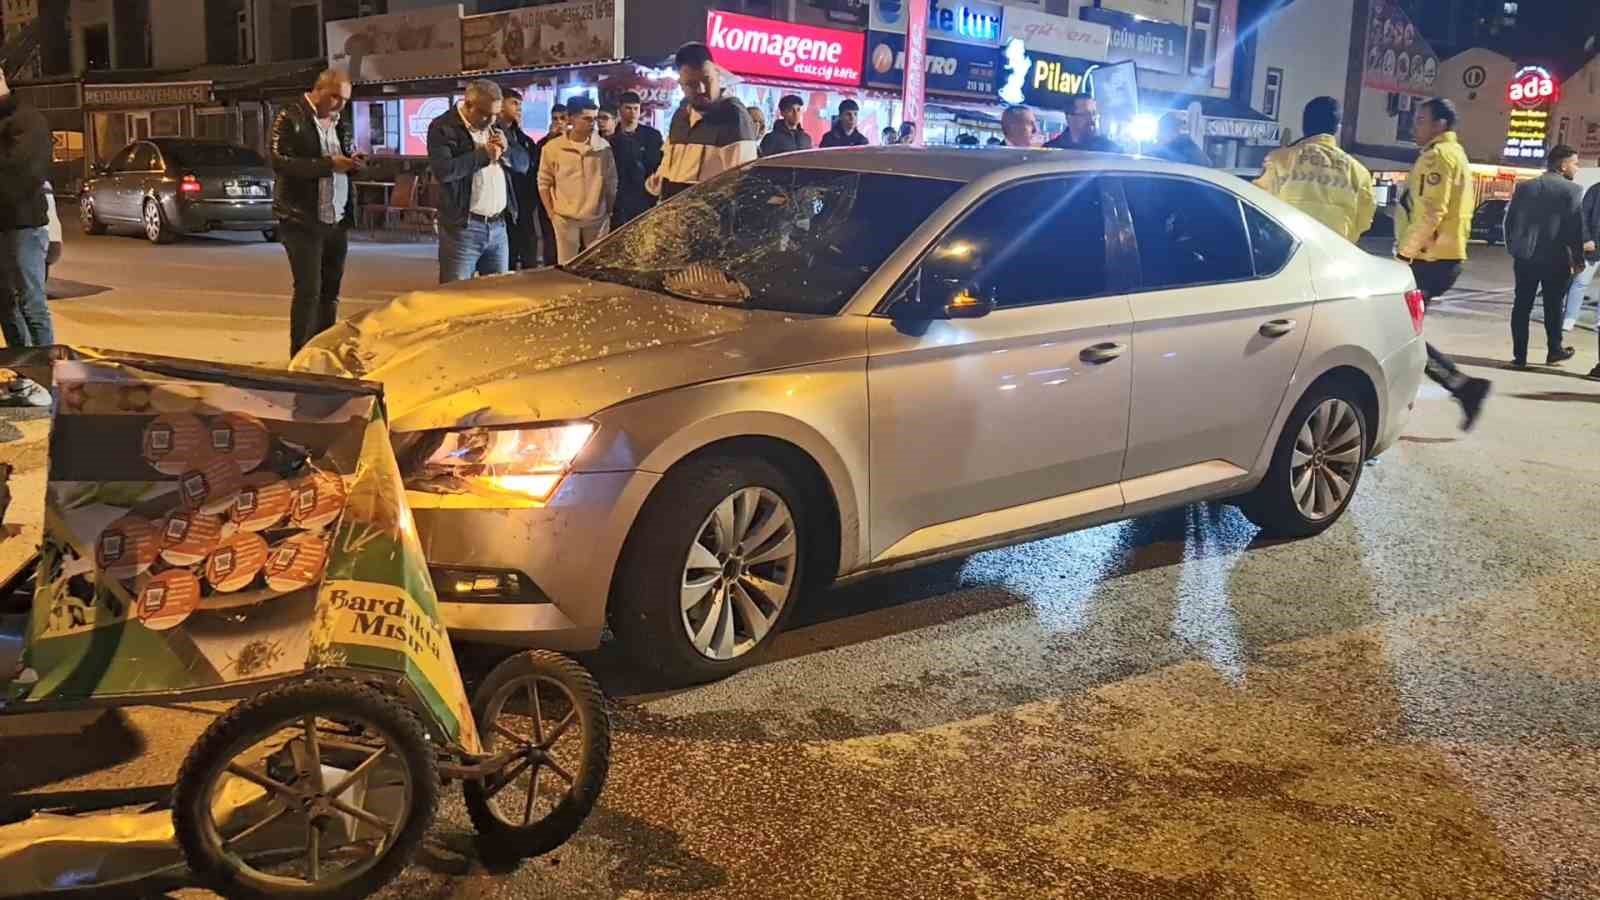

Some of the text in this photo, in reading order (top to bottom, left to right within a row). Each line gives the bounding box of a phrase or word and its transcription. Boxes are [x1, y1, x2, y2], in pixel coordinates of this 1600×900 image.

[710, 15, 842, 67] komagene
[894, 52, 957, 76] MTRO
[1509, 76, 1553, 101] ada
